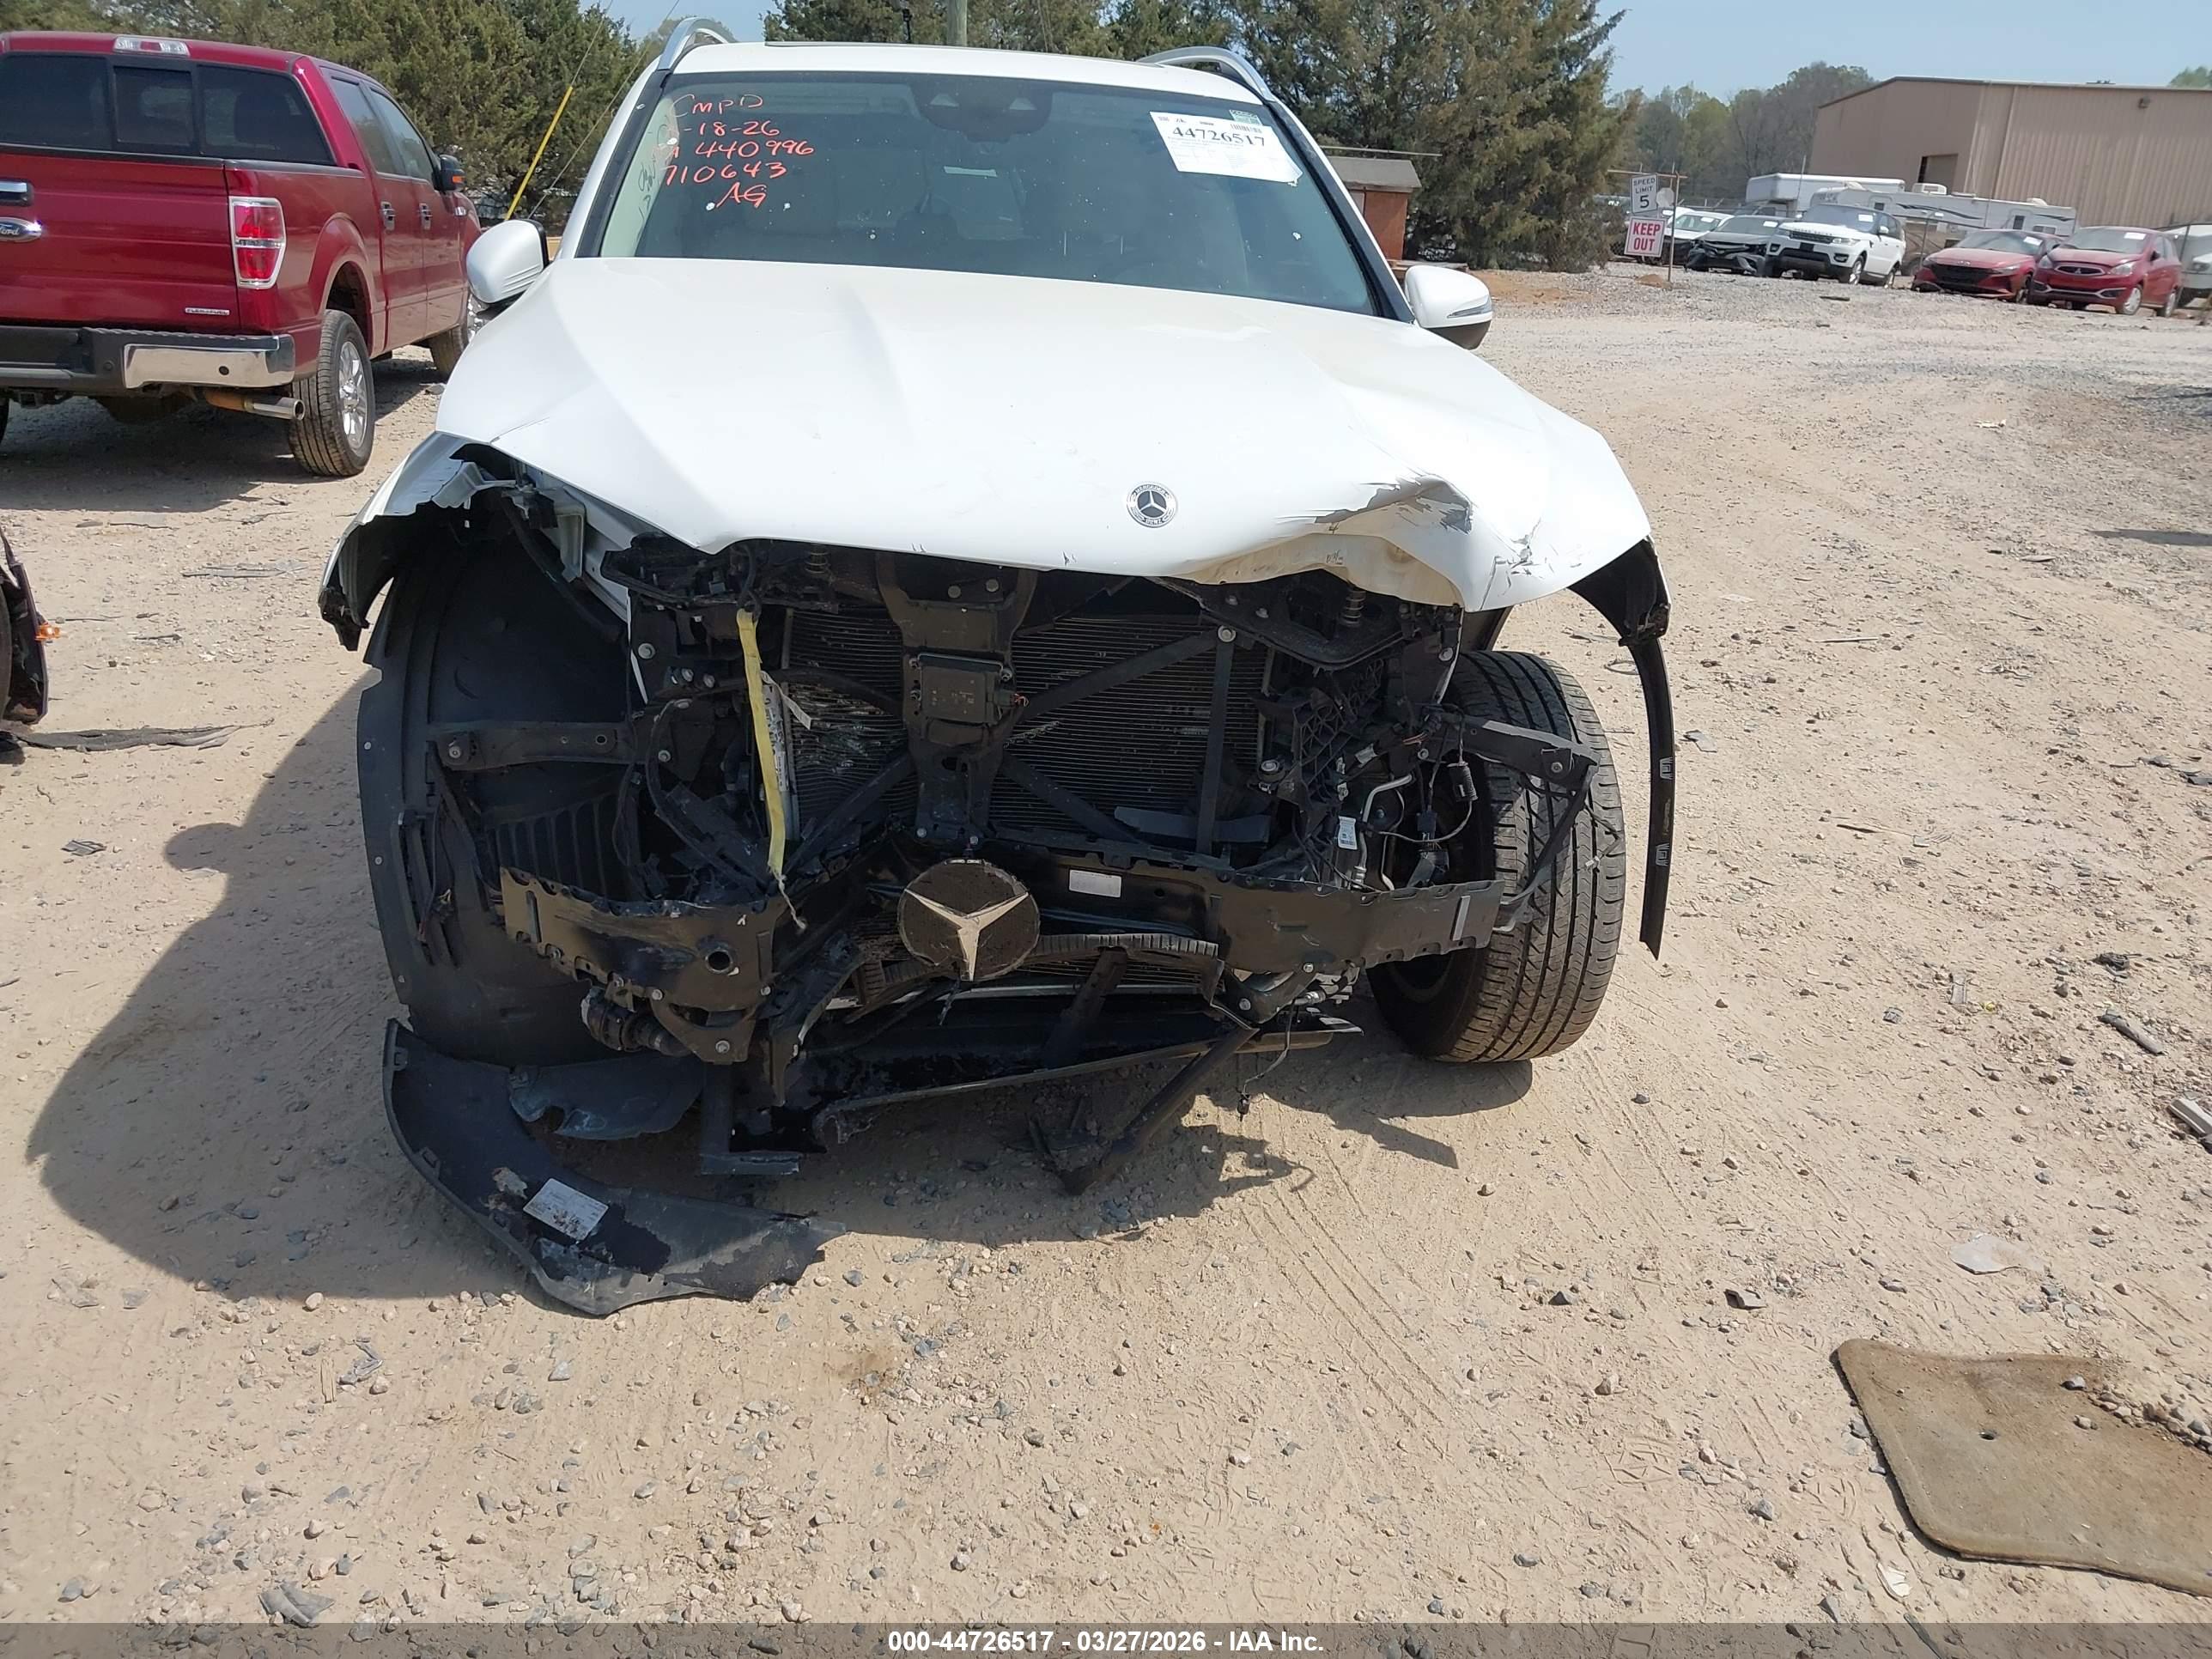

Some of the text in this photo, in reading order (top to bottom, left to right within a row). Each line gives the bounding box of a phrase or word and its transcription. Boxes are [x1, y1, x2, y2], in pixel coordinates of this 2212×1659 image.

[672, 94, 763, 117] CMPD
[1172, 127, 1265, 147] 44726517
[661, 161, 787, 185] 710643
[1633, 178, 1656, 186] SPEED
[716, 181, 767, 208] AG
[1640, 194, 1650, 208] 5
[1632, 222, 1661, 236] KEEP
[1633, 237, 1656, 252] OUT
